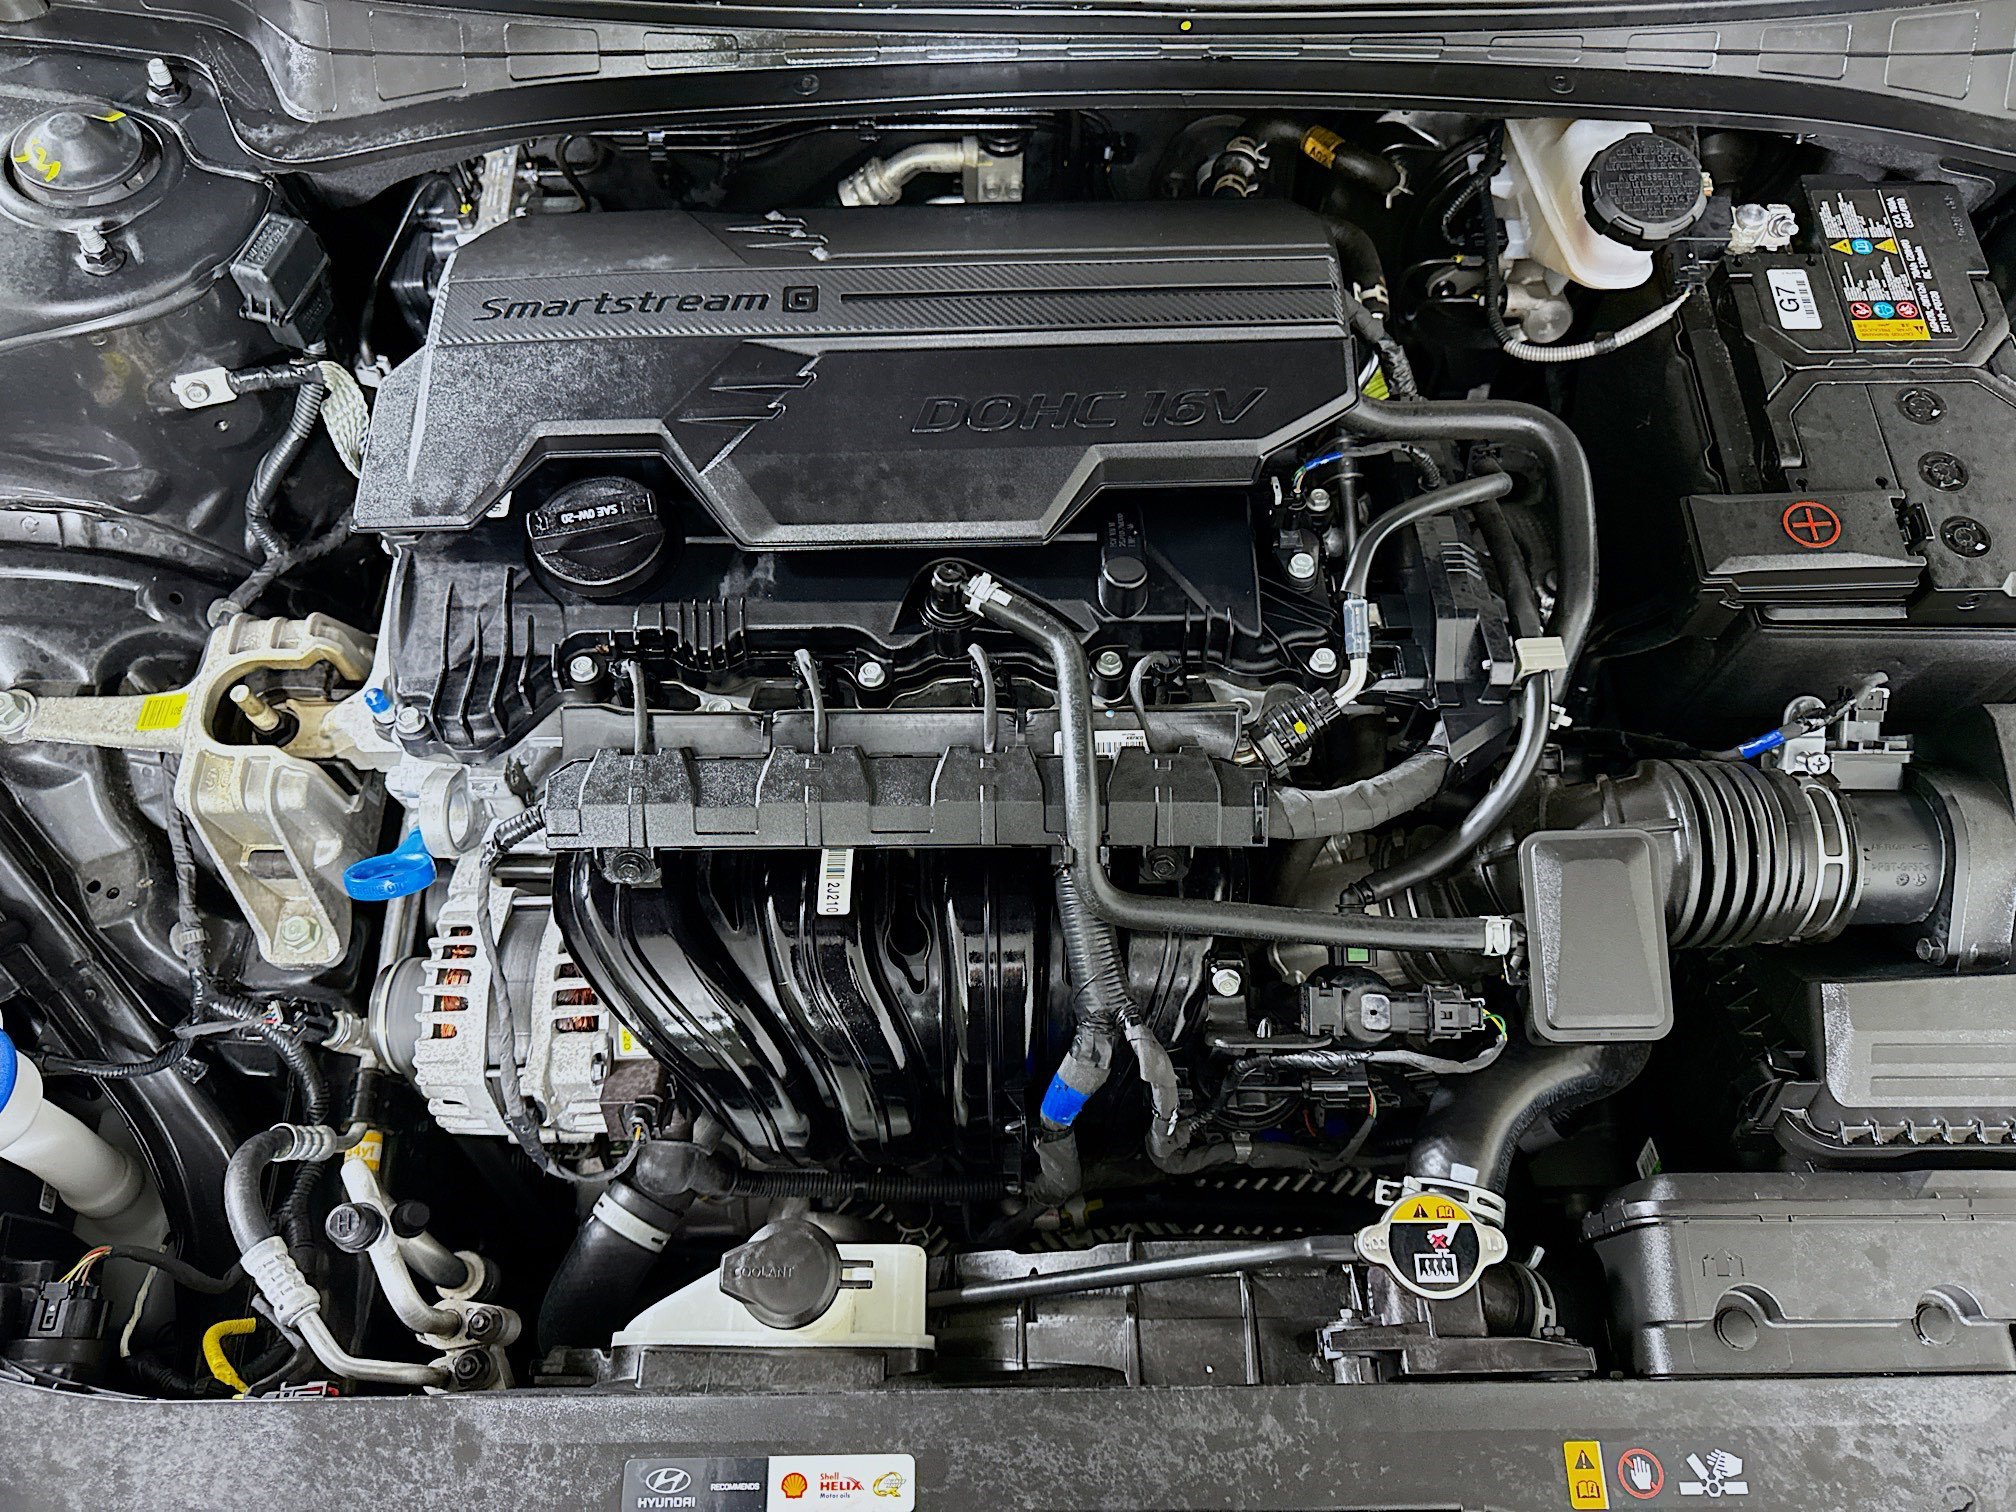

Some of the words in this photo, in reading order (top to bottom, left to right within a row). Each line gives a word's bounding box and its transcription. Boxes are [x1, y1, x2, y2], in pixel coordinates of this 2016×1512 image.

[473, 291, 771, 321] Smartstream
[786, 287, 816, 311] G
[1776, 286, 1800, 312] G7
[912, 391, 1127, 432] DOHC
[1143, 387, 1269, 427] 16V
[560, 506, 597, 525] 0W-20
[596, 501, 619, 517] SAE
[825, 882, 842, 913] 2J210
[337, 1213, 352, 1232] H
[734, 1265, 795, 1278] COOLANT
[820, 1472, 839, 1481] Shell
[820, 1481, 862, 1491] HELIX
[637, 1496, 696, 1509] HYUNDAI
[710, 1482, 760, 1491] RECOMMENDS
